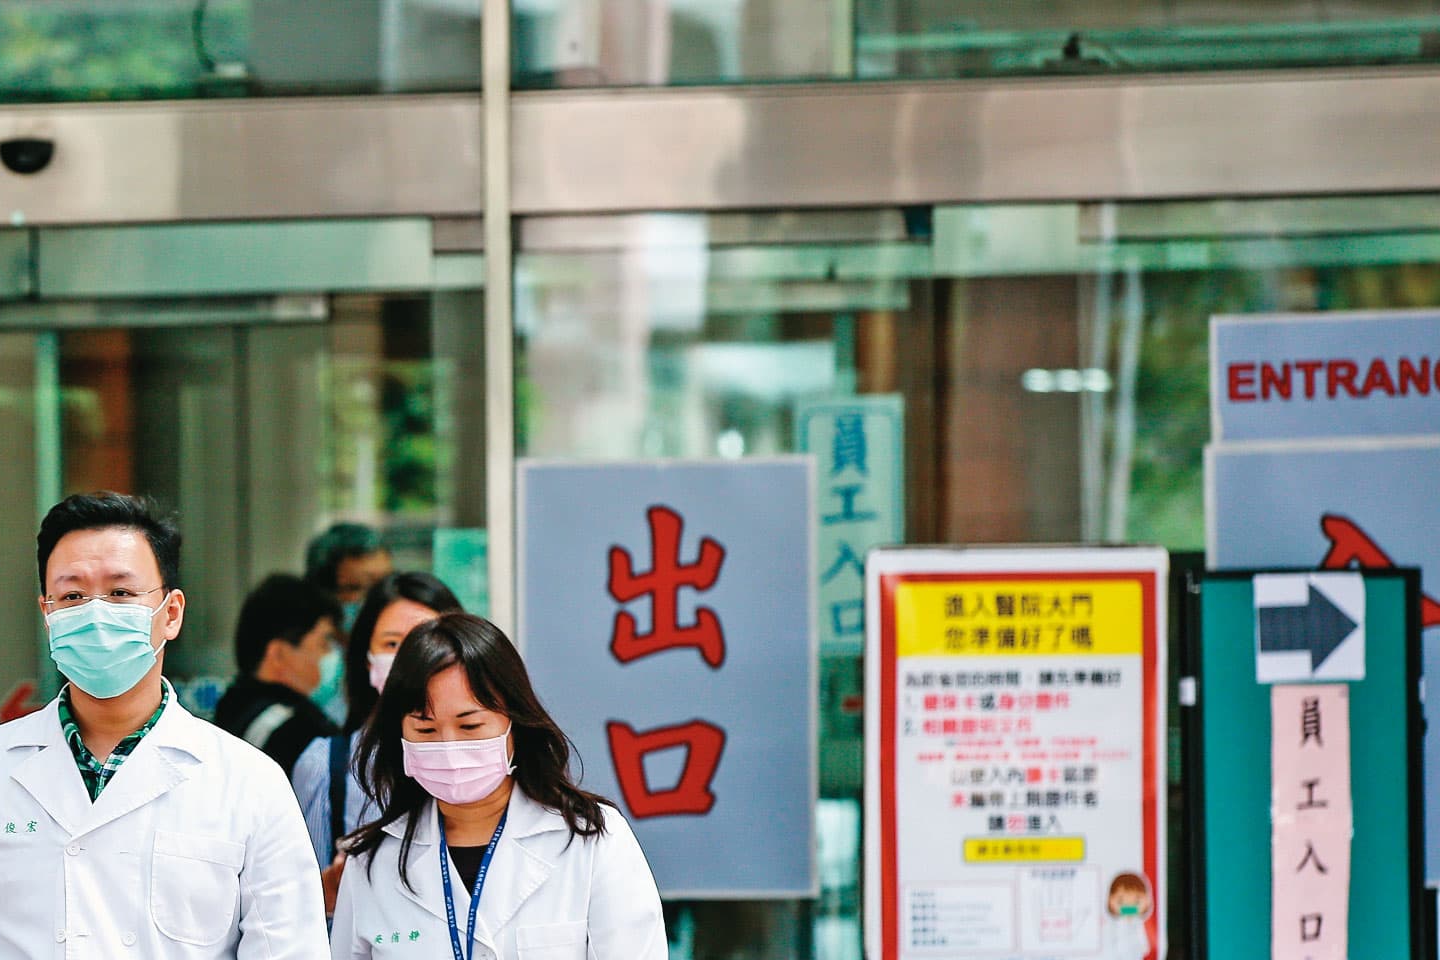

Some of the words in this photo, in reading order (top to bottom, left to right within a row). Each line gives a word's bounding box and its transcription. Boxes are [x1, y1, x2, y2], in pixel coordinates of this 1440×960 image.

[1227, 356, 1440, 402] ENTRAN
[821, 413, 878, 636] 員工入口
[606, 504, 727, 820] 出口
[945, 593, 1093, 618] 進入醫院大門
[945, 626, 1093, 649] 您準備好了嗎
[1296, 696, 1329, 942] 員工入口
